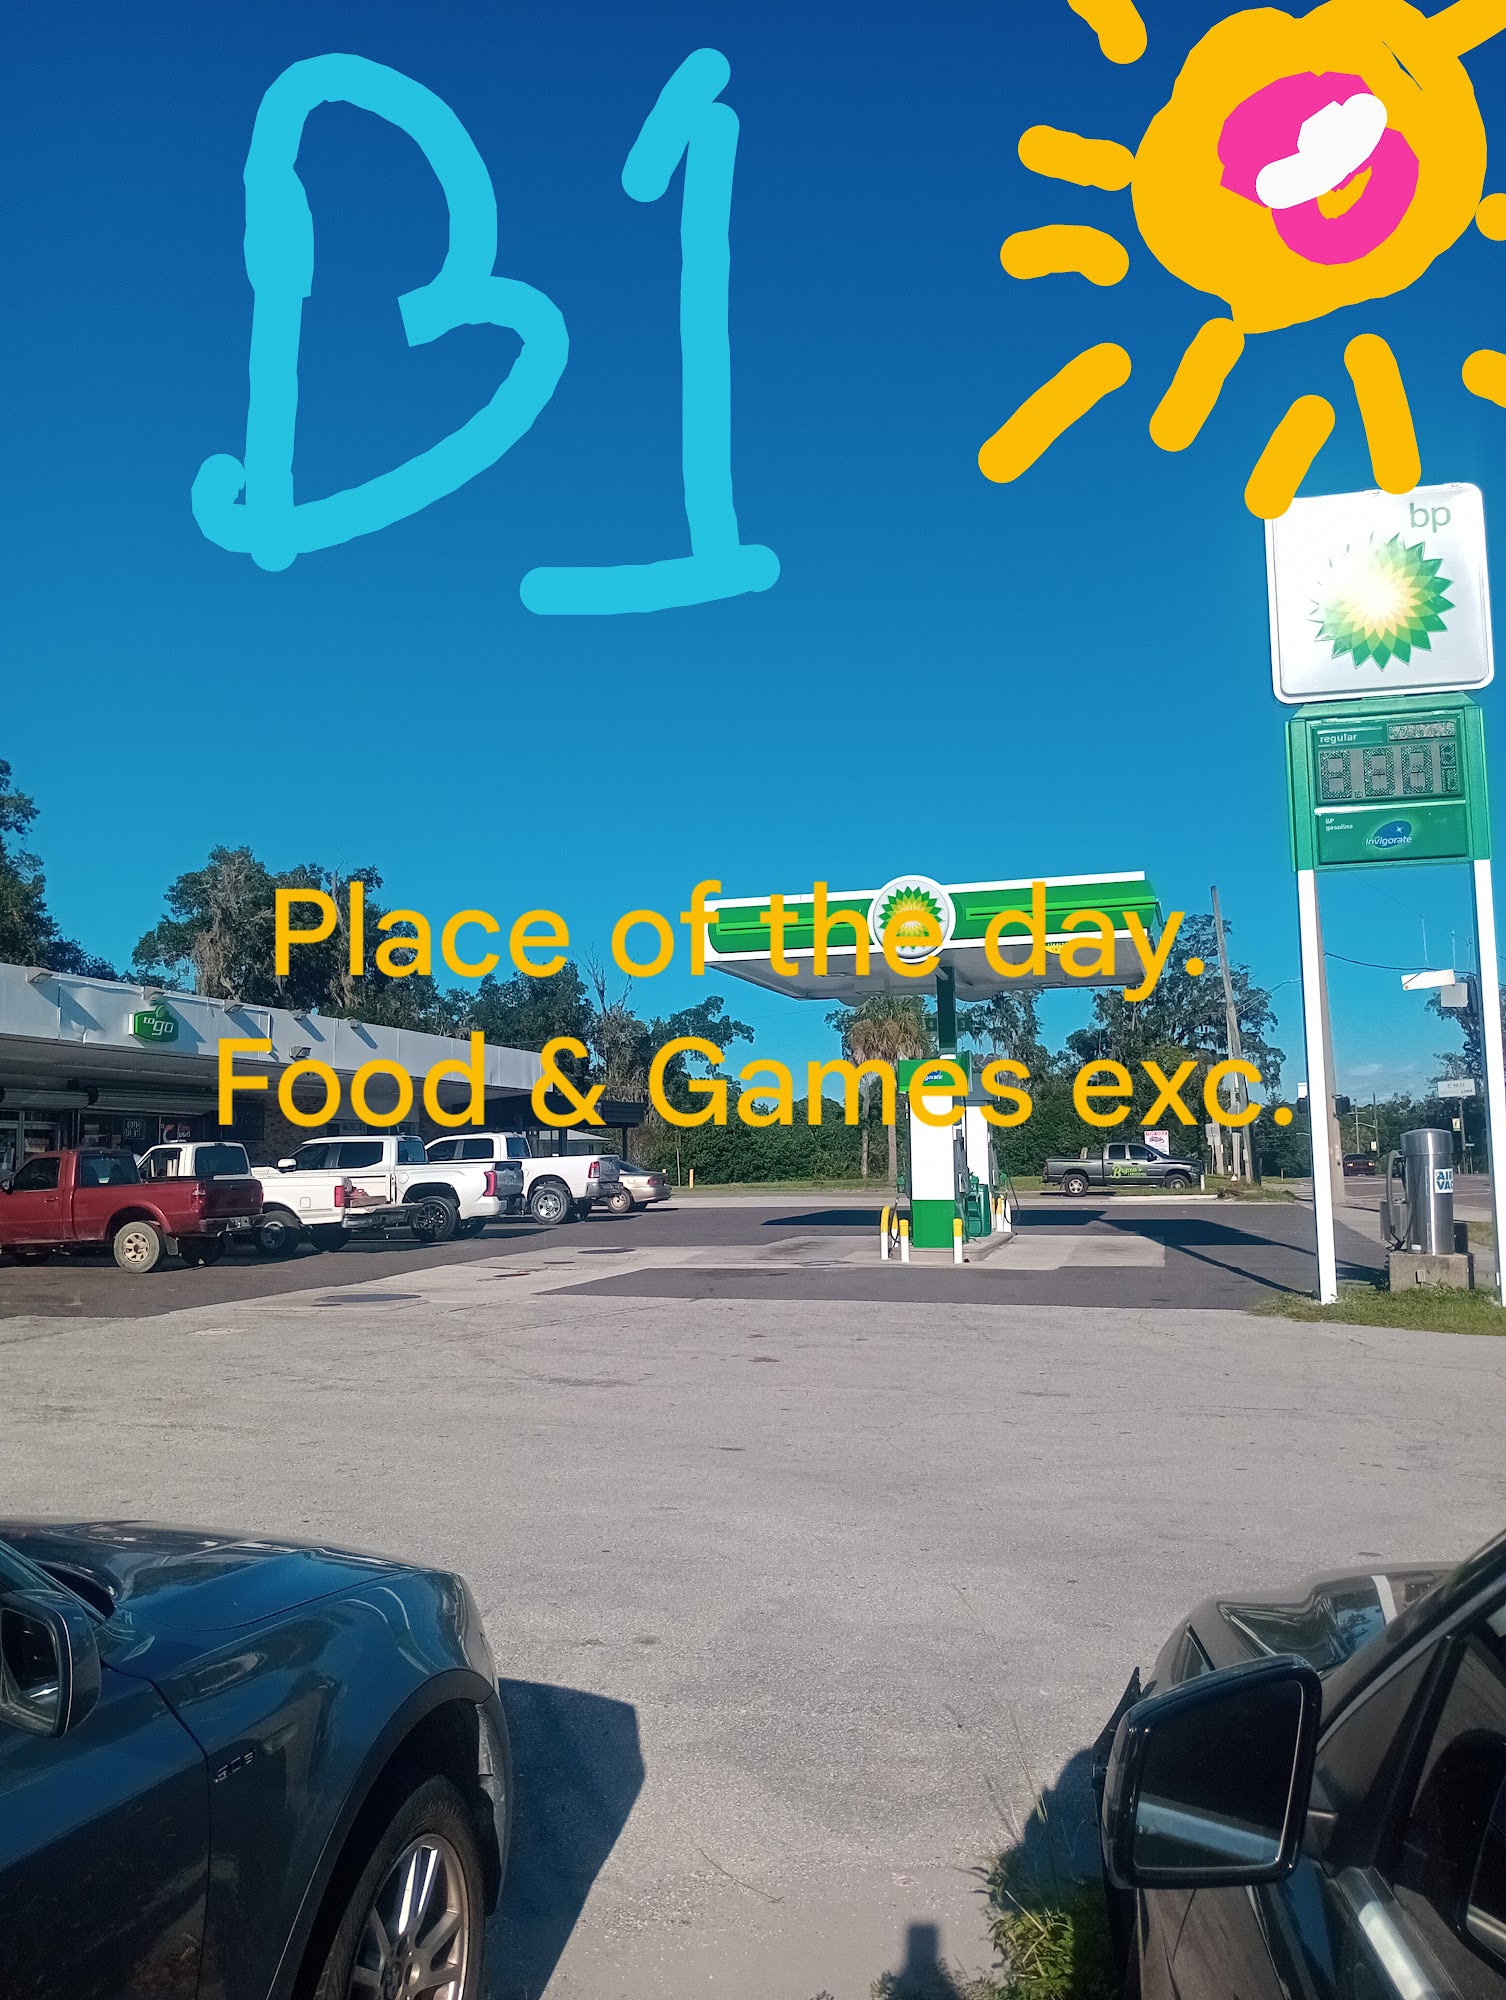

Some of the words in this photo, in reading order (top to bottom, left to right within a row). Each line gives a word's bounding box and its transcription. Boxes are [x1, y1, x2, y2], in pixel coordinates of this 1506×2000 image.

[1409, 502, 1451, 533] bp
[1319, 732, 1358, 745] regular
[151, 1020, 175, 1036] go
